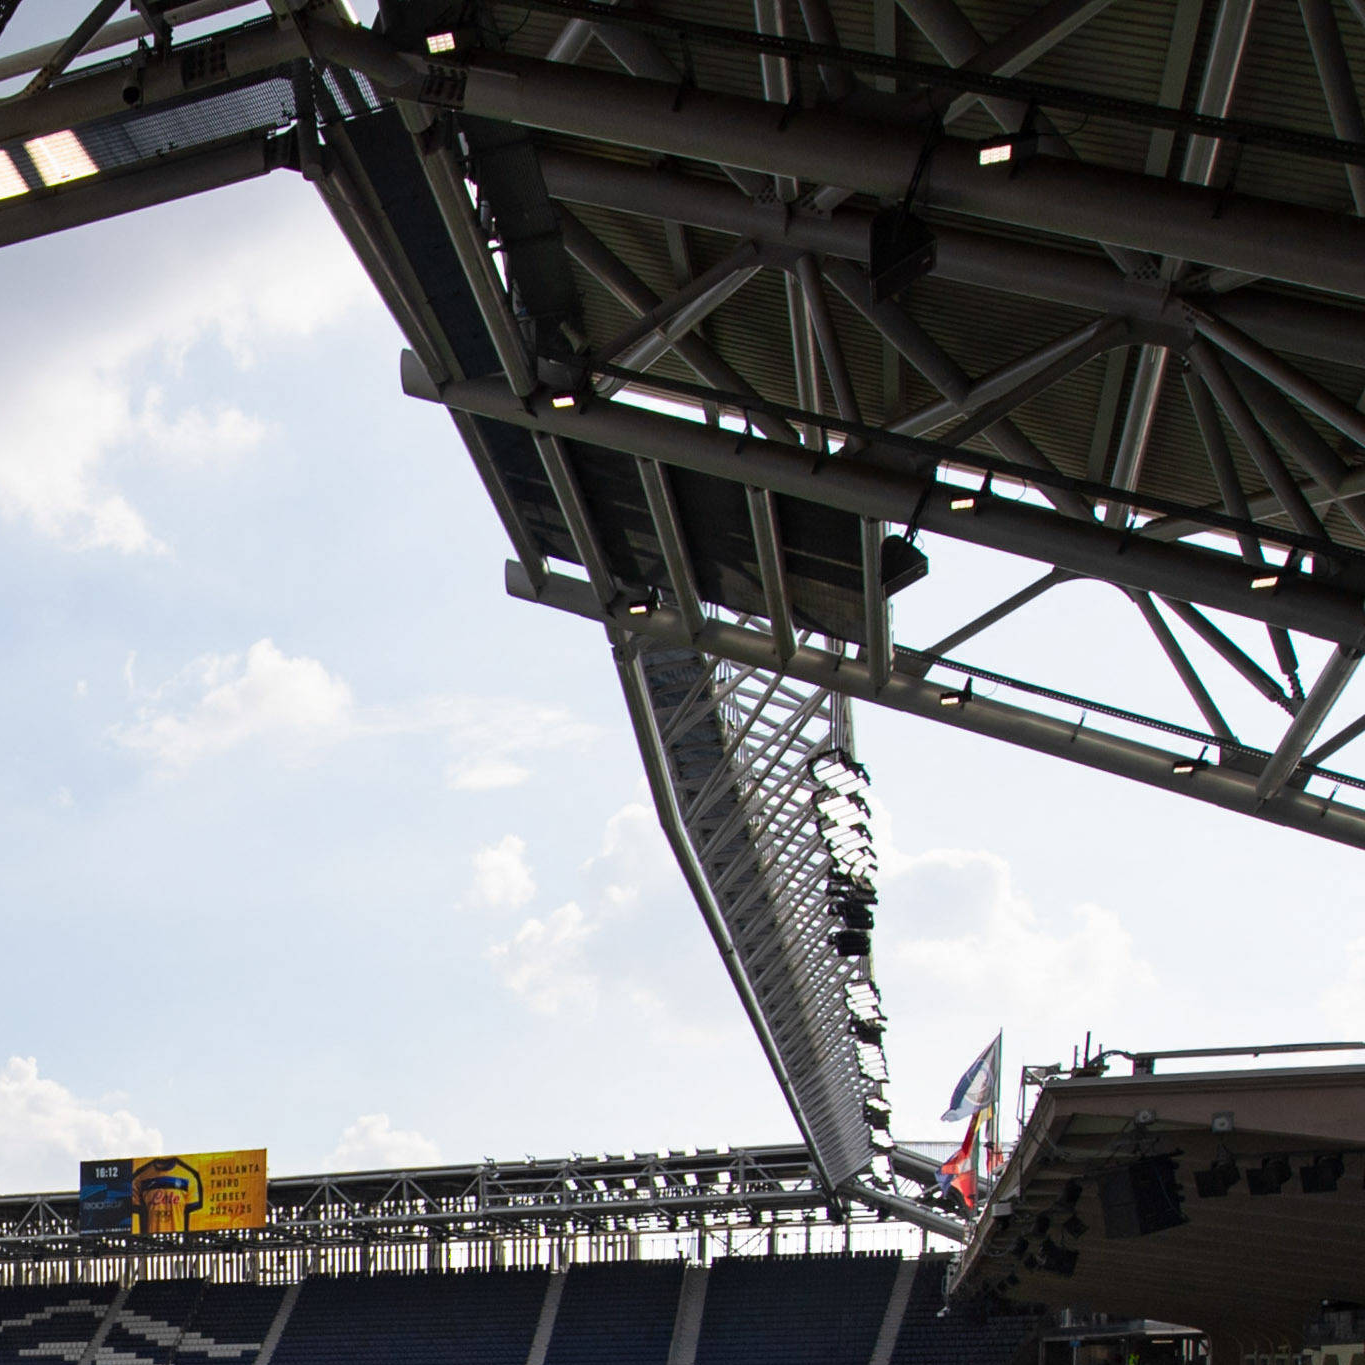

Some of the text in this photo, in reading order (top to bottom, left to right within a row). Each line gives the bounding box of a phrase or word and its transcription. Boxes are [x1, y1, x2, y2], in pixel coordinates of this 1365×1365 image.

[95, 1166, 118, 1179] 16:12
[210, 1164, 259, 1176] ATALANTA
[210, 1192, 246, 1202] JERSEY
